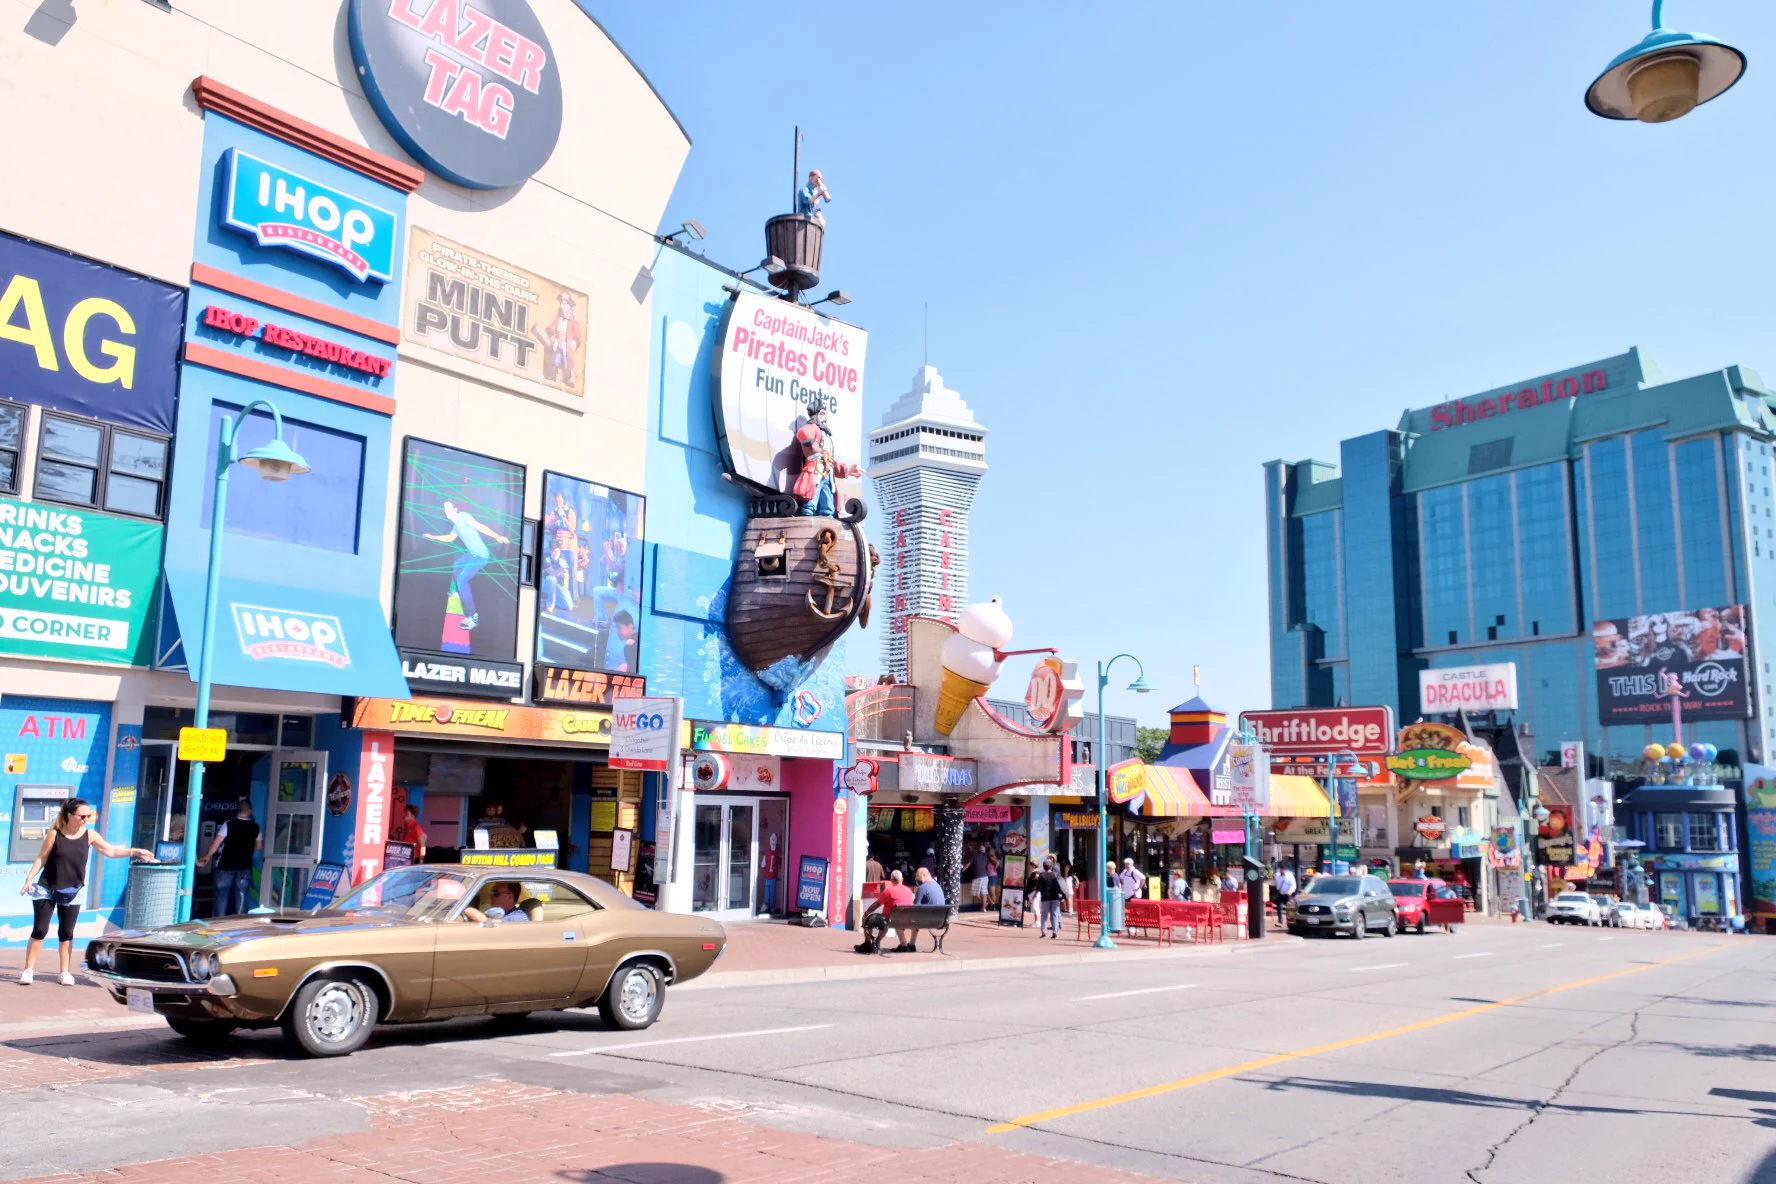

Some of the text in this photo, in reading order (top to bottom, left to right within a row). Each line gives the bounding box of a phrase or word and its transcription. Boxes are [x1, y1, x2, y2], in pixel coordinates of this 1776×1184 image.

[424, 49, 514, 140] TAG
[258, 171, 374, 250] IHOP
[266, 226, 362, 269] RESTAURANT
[419, 251, 540, 305] GLOW-IN-THE-DARK
[432, 242, 531, 289] PIRATE-THEMED
[427, 267, 529, 335] MINI
[203, 305, 392, 377] IHOP RESTAURANT
[415, 301, 537, 369] PUTT
[753, 308, 849, 356] Captain Jack's
[732, 326, 857, 393] Pirates Cove
[755, 367, 784, 396] Fun
[1430, 368, 1609, 432] Sheraton
[894, 508, 908, 634] CASINO
[939, 508, 954, 623] CASIN
[12, 615, 111, 641] CORNER
[241, 611, 336, 650] IHOP
[402, 661, 521, 688] LAZER MAZE
[543, 667, 645, 704] LAZER TAG
[1442, 670, 1487, 681] CASTLE
[1608, 673, 1657, 697] THIS
[1682, 667, 1738, 684] Hard Rock
[1426, 679, 1507, 704] DRACULA
[390, 701, 510, 731] TIME FREAK
[1639, 702, 1662, 713] ROCK
[18, 715, 87, 740] ATM
[1283, 766, 1295, 775] At
[1297, 765, 1315, 775] the
[204, 801, 237, 813] pepsi
[363, 741, 387, 845] LAZER
[159, 845, 180, 859] IHOP
[1005, 836, 1017, 844] DQ
[509, 853, 536, 867] COMBO
[536, 852, 555, 865] PASS
[803, 864, 823, 875] IHOP
[315, 869, 338, 884] IHOP
[802, 885, 820, 894] NOW
[799, 893, 821, 902] OPEN
